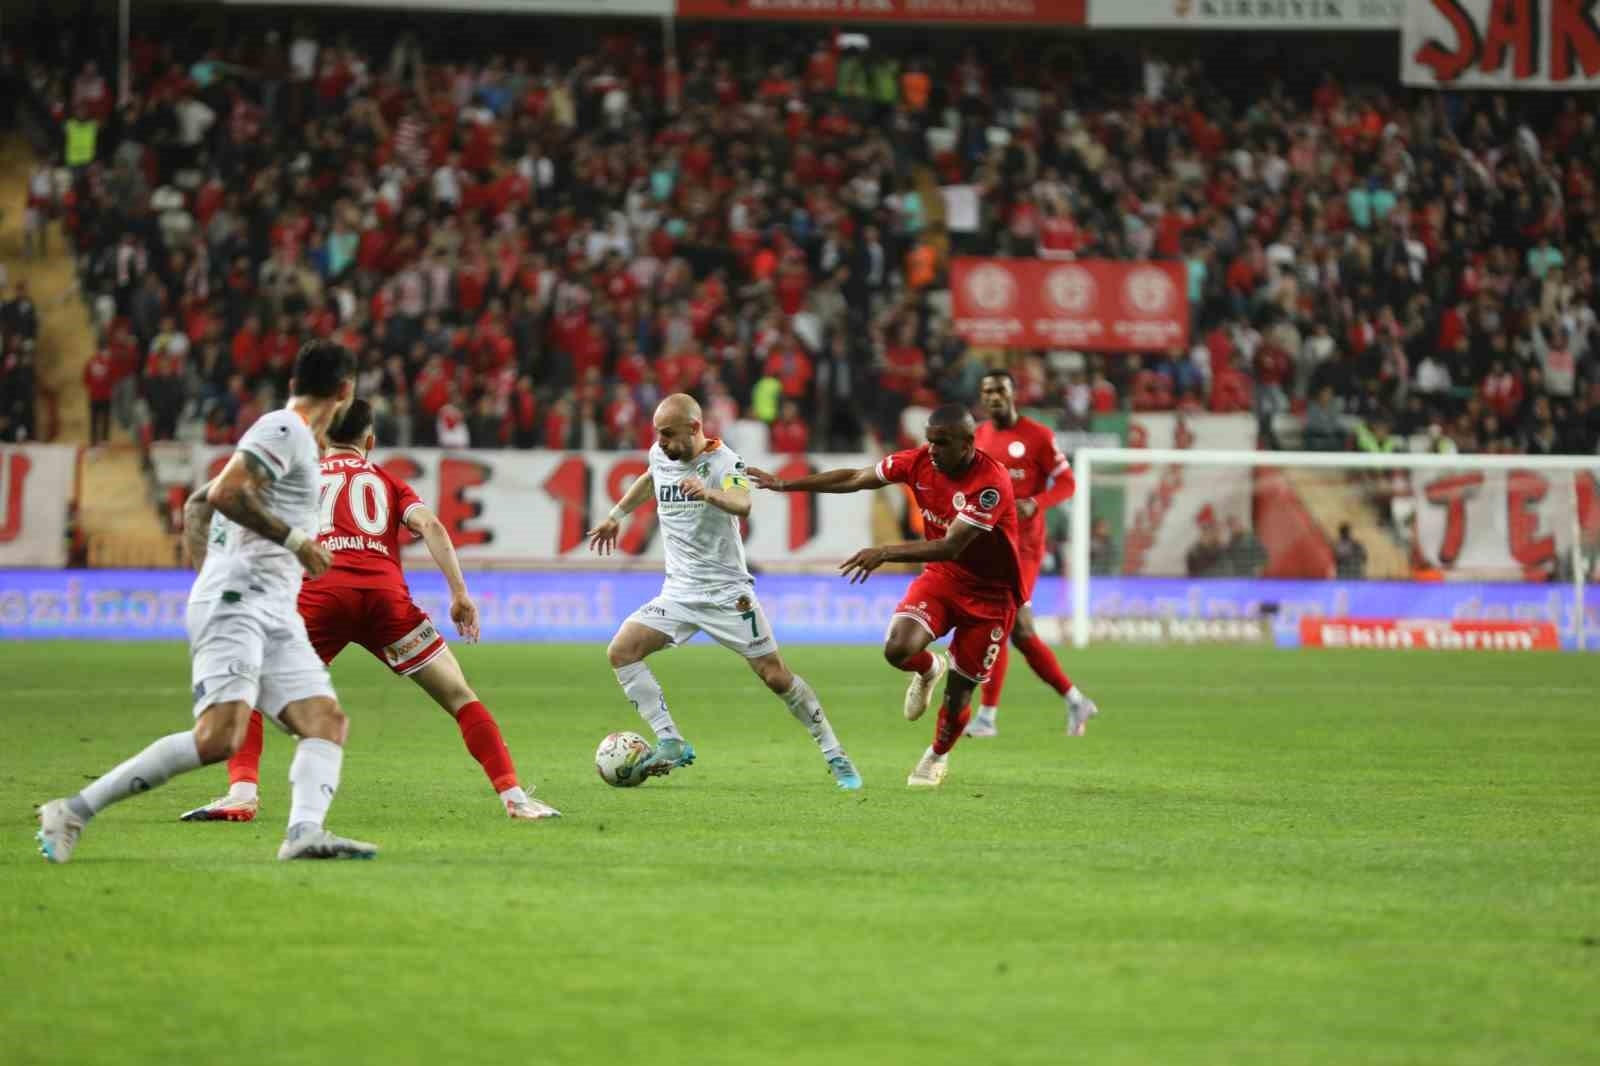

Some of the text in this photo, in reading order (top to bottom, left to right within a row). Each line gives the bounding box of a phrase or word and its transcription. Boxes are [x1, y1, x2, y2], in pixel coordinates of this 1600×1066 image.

[319, 535, 365, 551] OĞUKAN
[741, 610, 759, 639] 7
[983, 643, 1000, 671] 8
